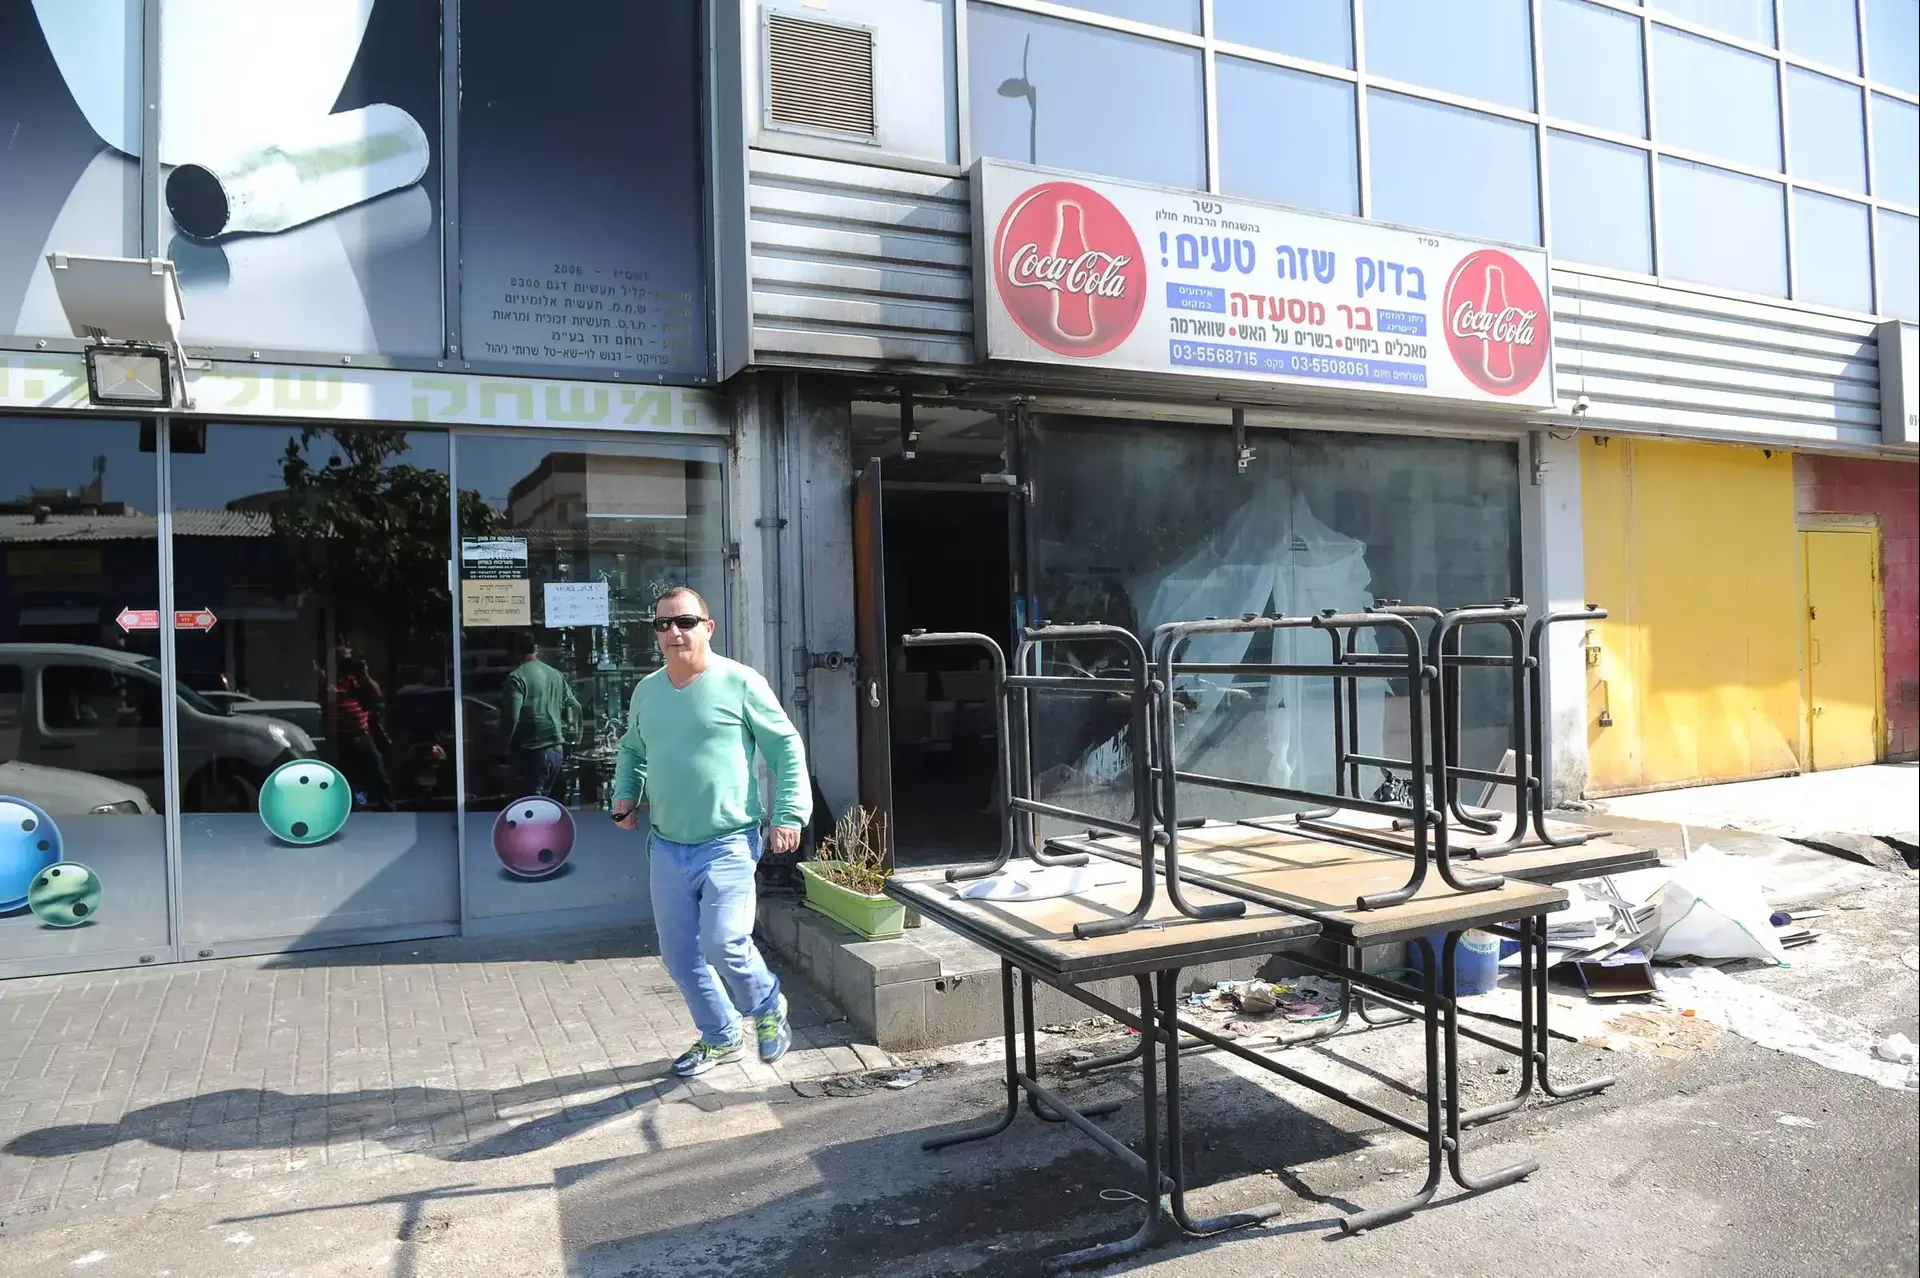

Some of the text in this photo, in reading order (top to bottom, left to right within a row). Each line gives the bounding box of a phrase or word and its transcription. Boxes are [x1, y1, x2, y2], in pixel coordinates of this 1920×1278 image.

[1192, 200, 1223, 215] כשר
[1155, 209, 1261, 233] בהשגחת הרבנות חולון
[553, 264, 583, 275] 2006
[1276, 245, 1335, 284] שזה
[510, 277, 540, 289] 8300
[1355, 256, 1427, 301] בדוק
[546, 280, 567, 291] דגם
[574, 282, 615, 296] תעשיות
[1178, 286, 1213, 298] אירועים
[505, 294, 557, 307] אלומיניום
[1181, 299, 1212, 310] במקום
[492, 310, 529, 322] ומראות
[1230, 292, 1373, 331] בר מסעדה
[535, 313, 566, 325] זכוכית
[572, 315, 610, 327] תעשיות
[1170, 317, 1225, 338] שווארמה
[1238, 324, 1266, 342] האש
[1272, 324, 1289, 344] על
[591, 334, 608, 344] דוד
[616, 335, 643, 346] רותם
[1295, 330, 1334, 349] בשרים
[485, 342, 508, 354] ניהול
[512, 345, 539, 356] שרותי
[1385, 338, 1427, 359] מאכלים
[1173, 344, 1258, 367] 03-5568715
[1291, 355, 1369, 377] 03-5508061
